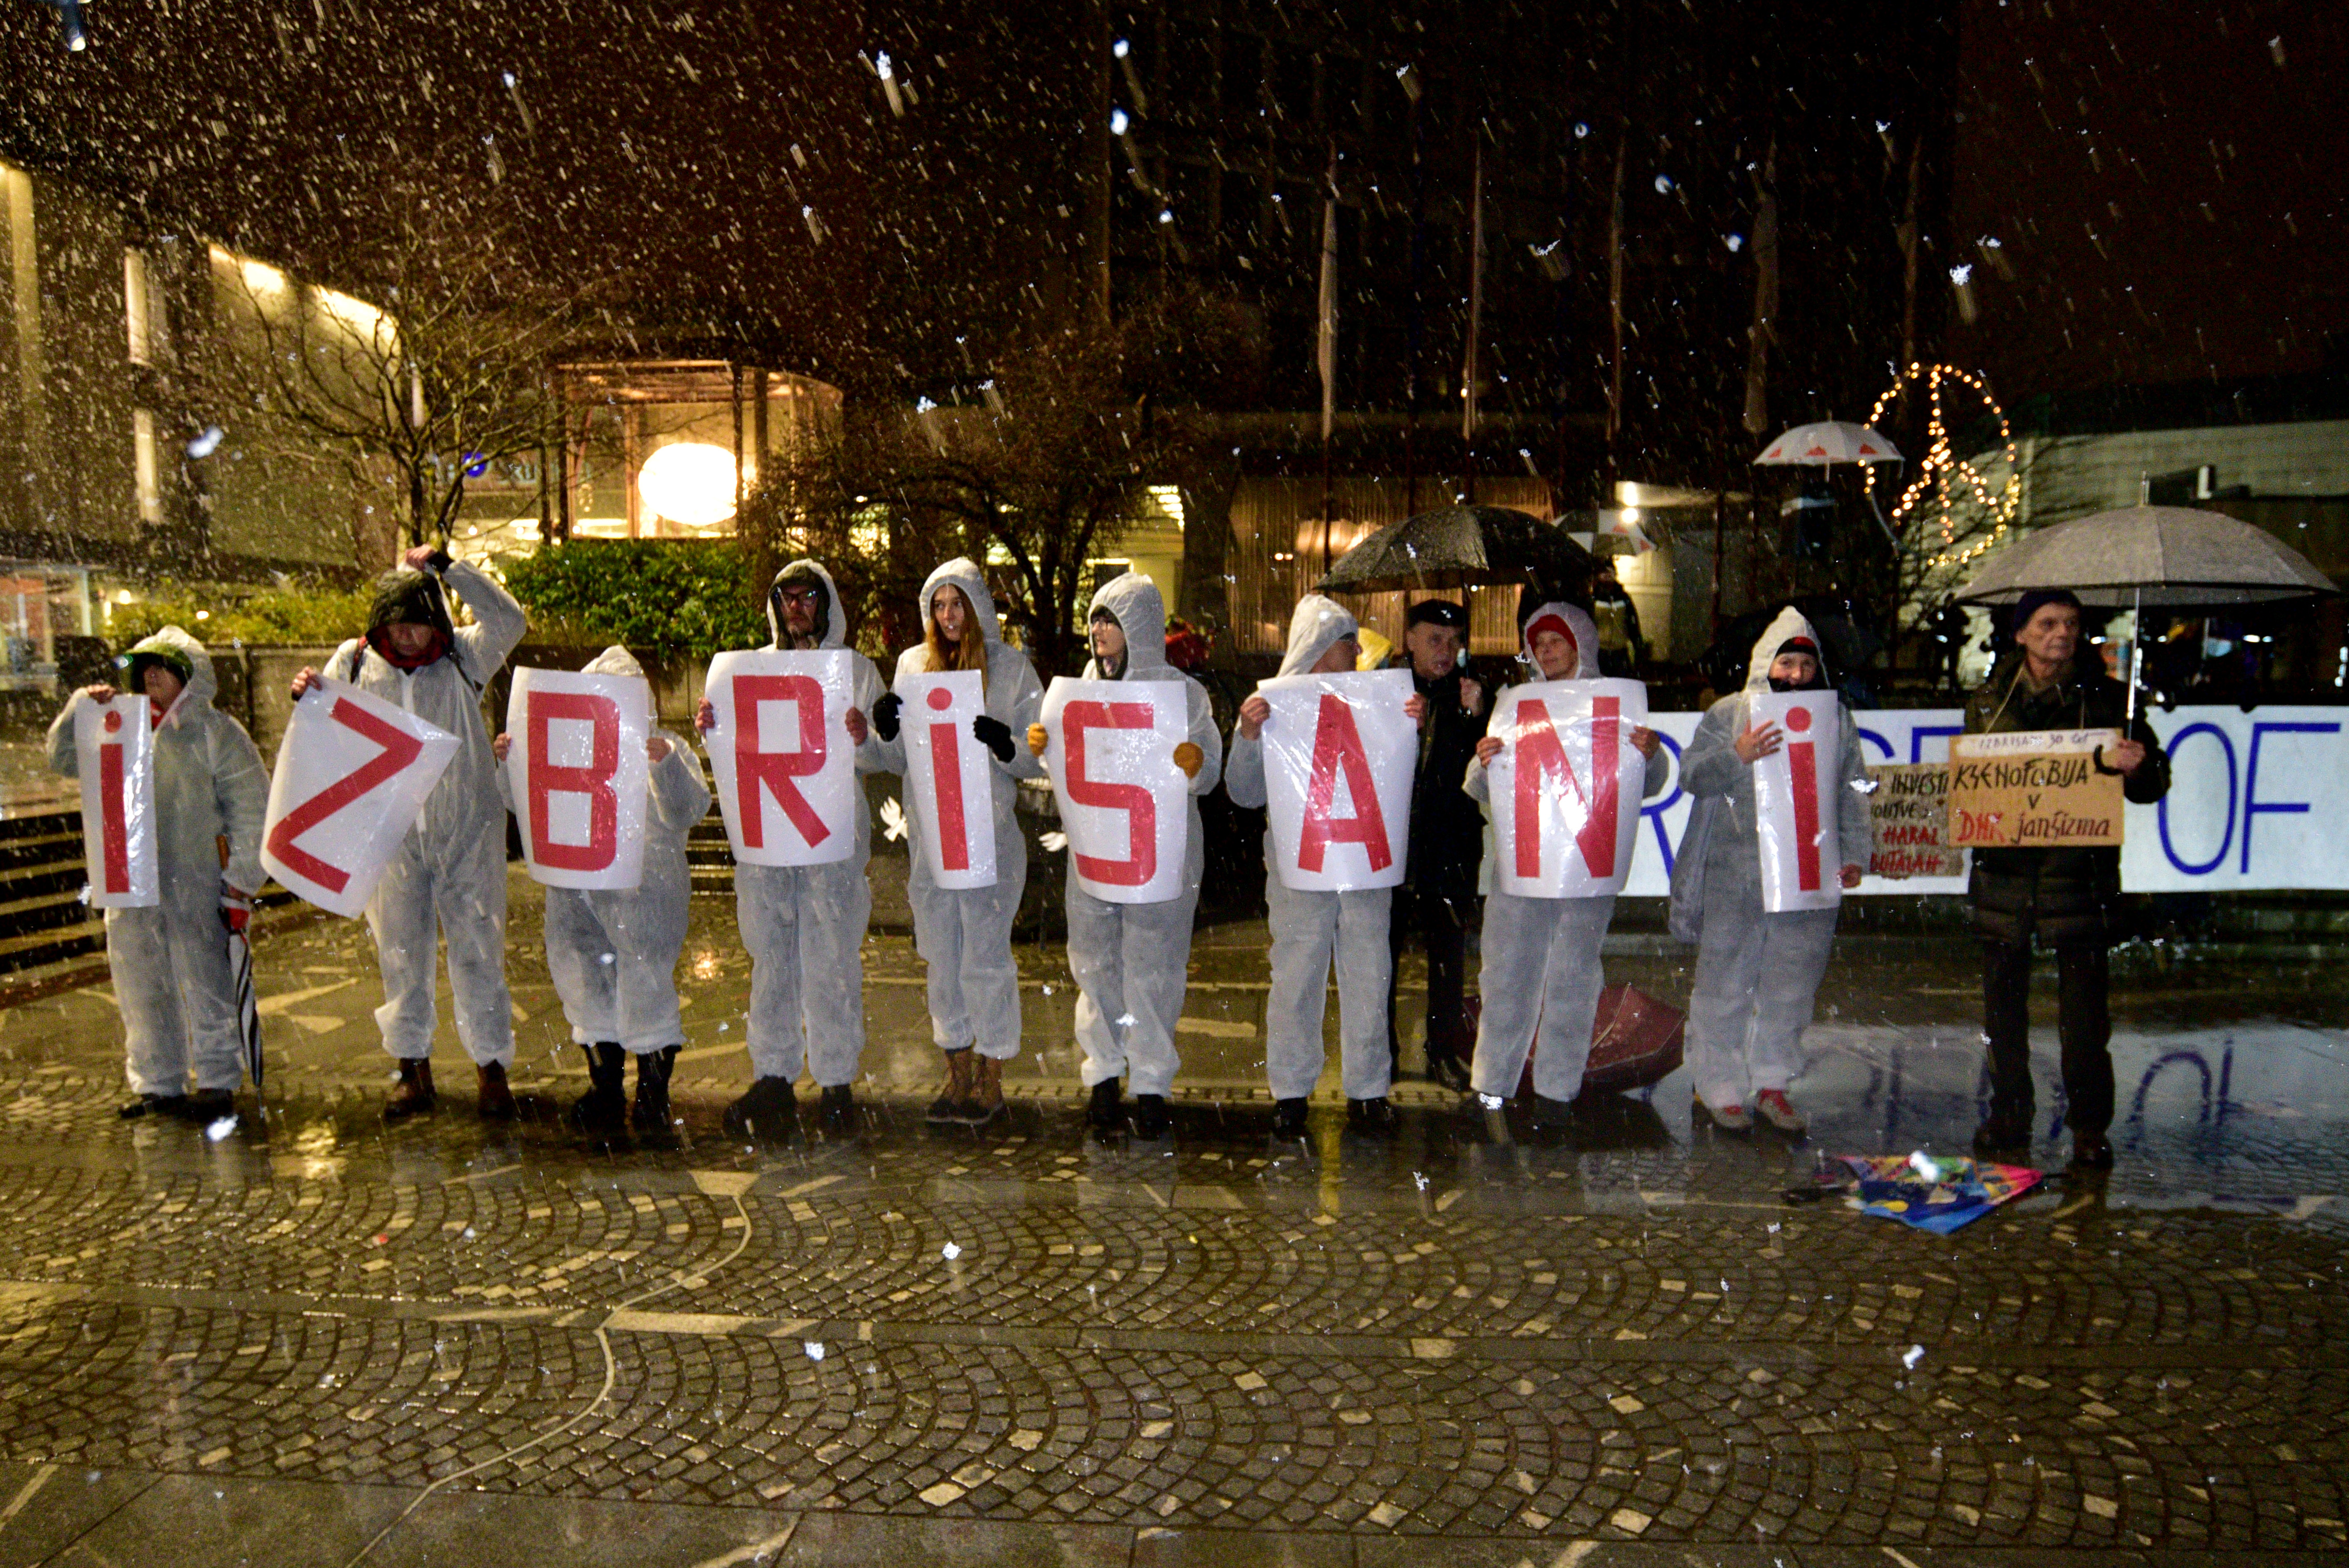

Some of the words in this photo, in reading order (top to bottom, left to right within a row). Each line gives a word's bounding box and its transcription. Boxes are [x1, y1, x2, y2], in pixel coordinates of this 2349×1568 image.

[267, 696, 424, 895] Z
[527, 691, 620, 872] B
[732, 675, 831, 849] R
[1062, 700, 1156, 886] S
[1298, 693, 1393, 873] A
[1515, 696, 1620, 878] N
[1953, 757, 2089, 791] KSENOFOBIJA
